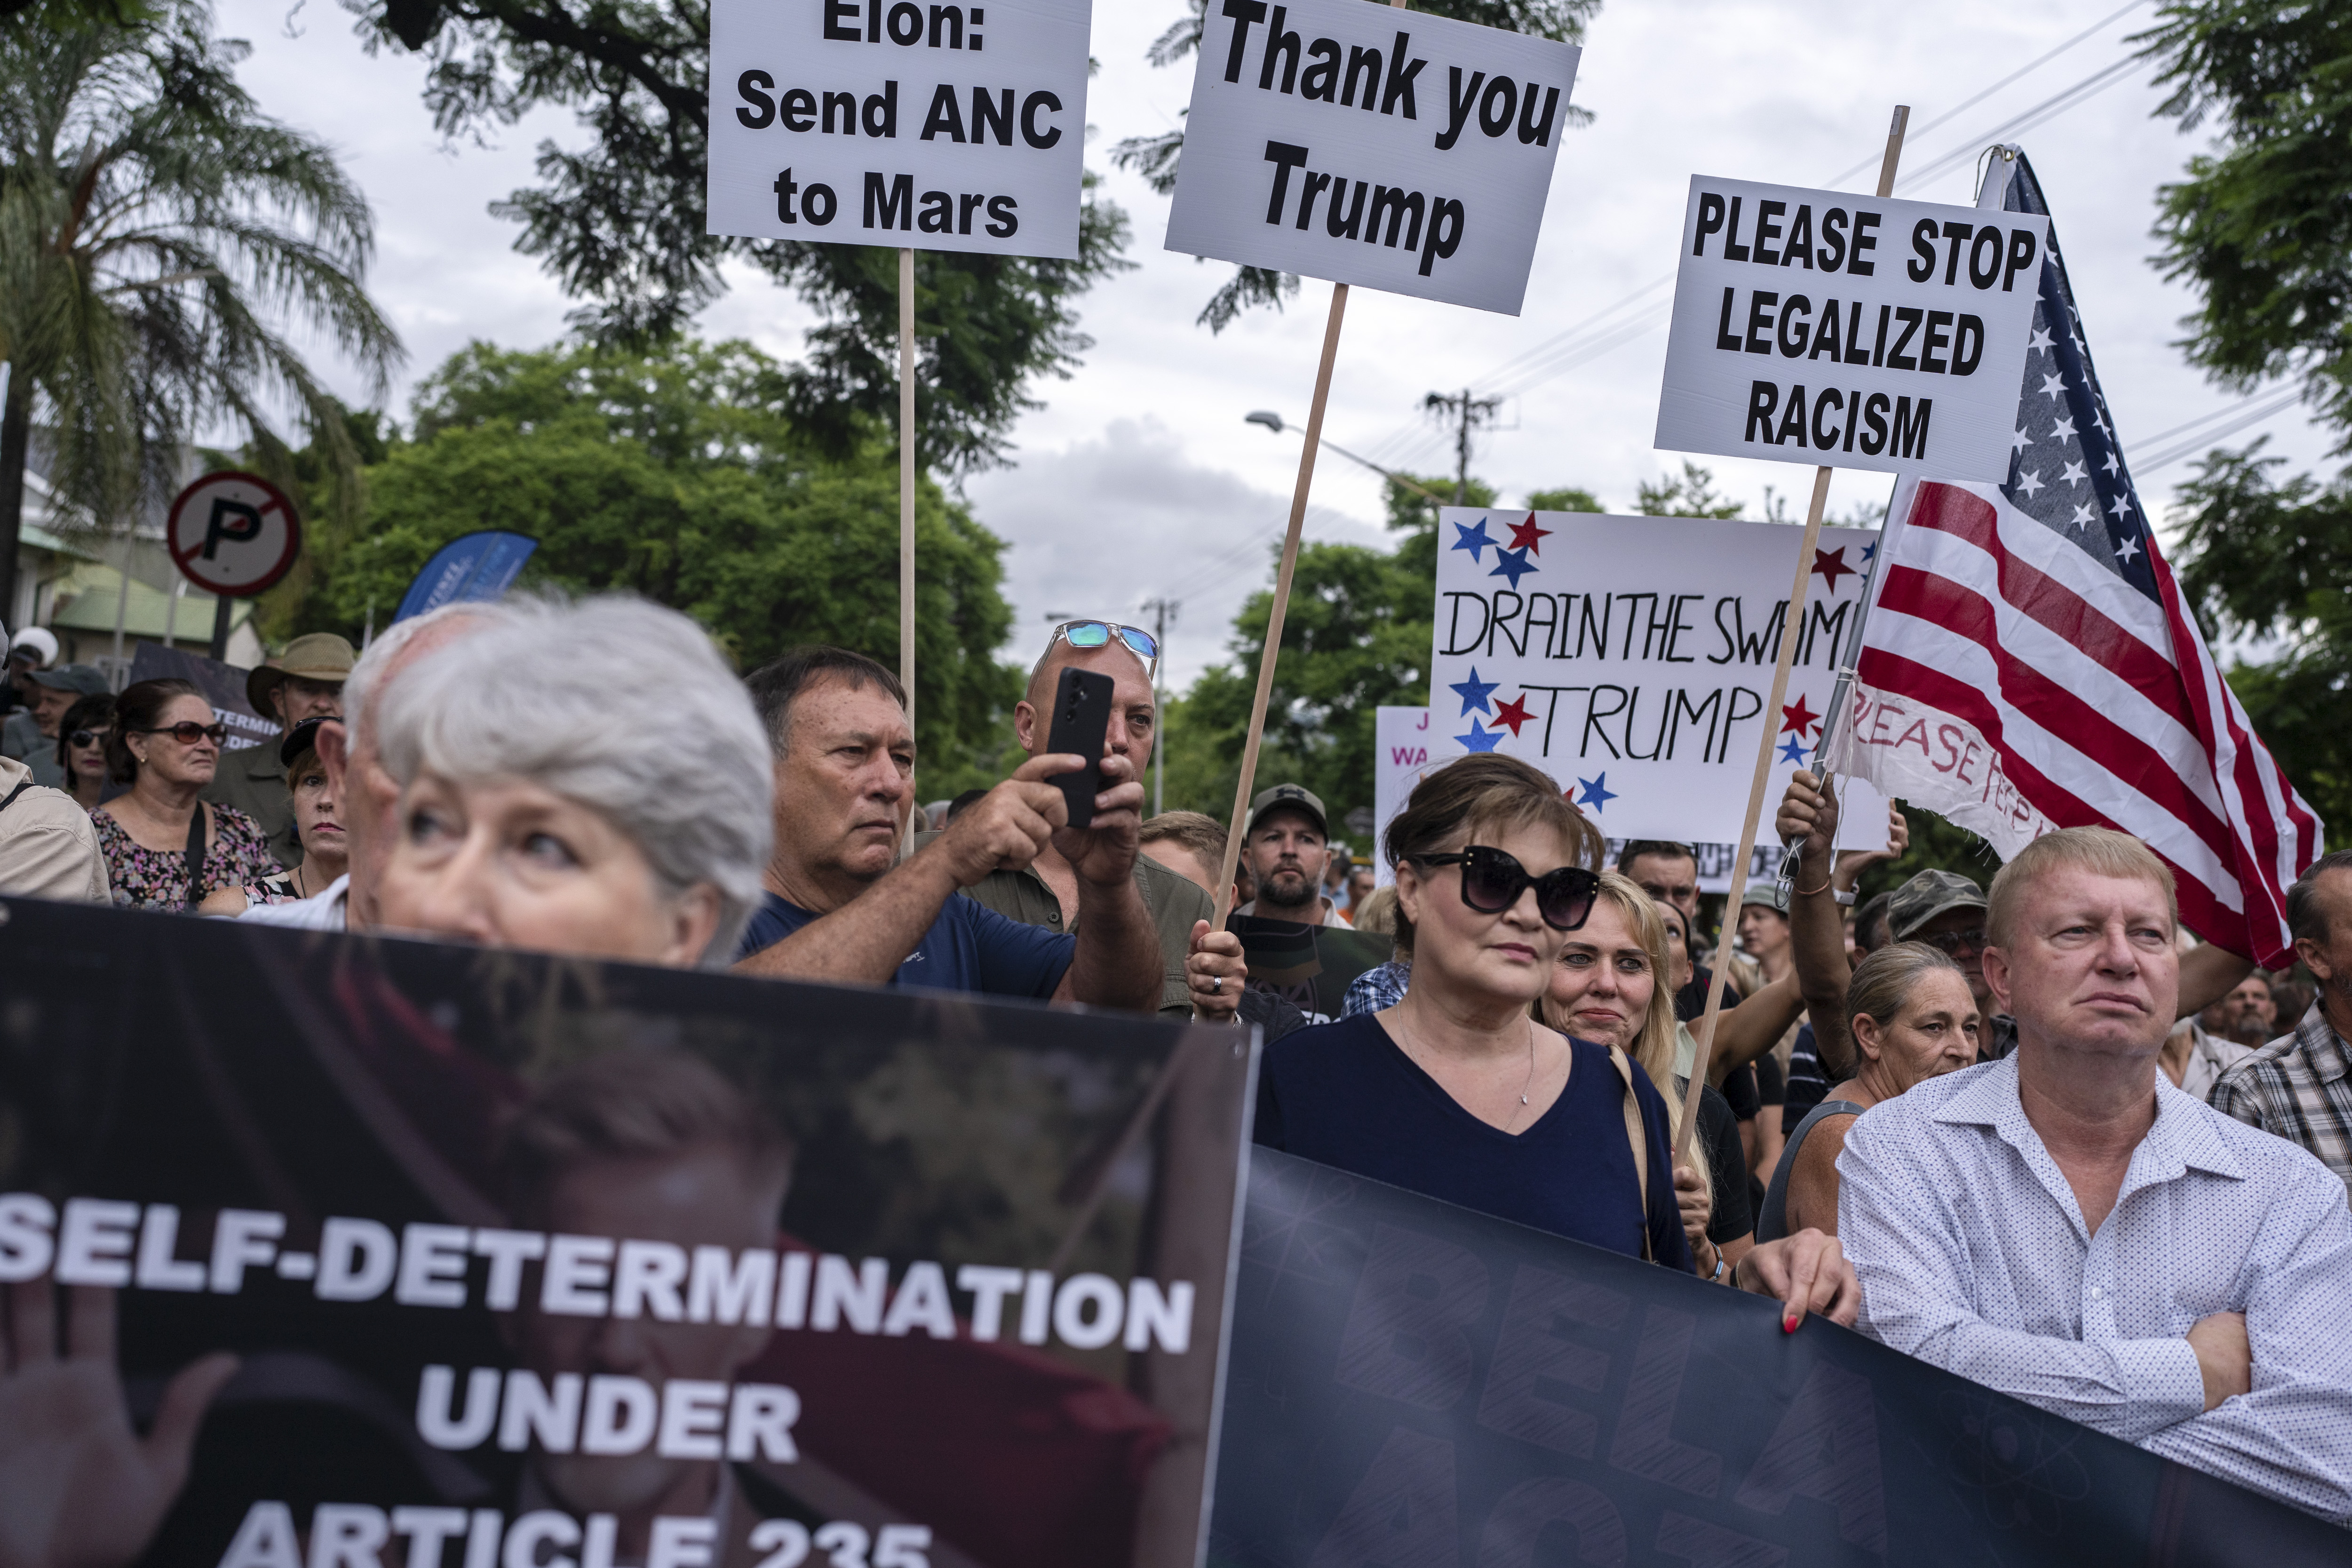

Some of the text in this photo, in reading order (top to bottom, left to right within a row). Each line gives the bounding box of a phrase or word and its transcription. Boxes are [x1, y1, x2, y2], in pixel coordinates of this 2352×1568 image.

[823, 0, 984, 51] Elon:
[736, 69, 1063, 150] Send ANC
[1222, 0, 1561, 151] Thank you
[774, 167, 1018, 238] to Mars
[1264, 140, 1465, 277] Trump
[1692, 192, 2036, 292] PLEASE STOP
[1716, 287, 1985, 376] LEGALIZED
[1744, 380, 1933, 460] RACISM
[1707, 596, 1860, 671] SWAM
[1518, 684, 1763, 764] TRUMP
[0, 1191, 1196, 1355] SELF-DETERMINATION
[414, 1363, 803, 1465] UNDER
[214, 1500, 719, 1568] ARTICLE
